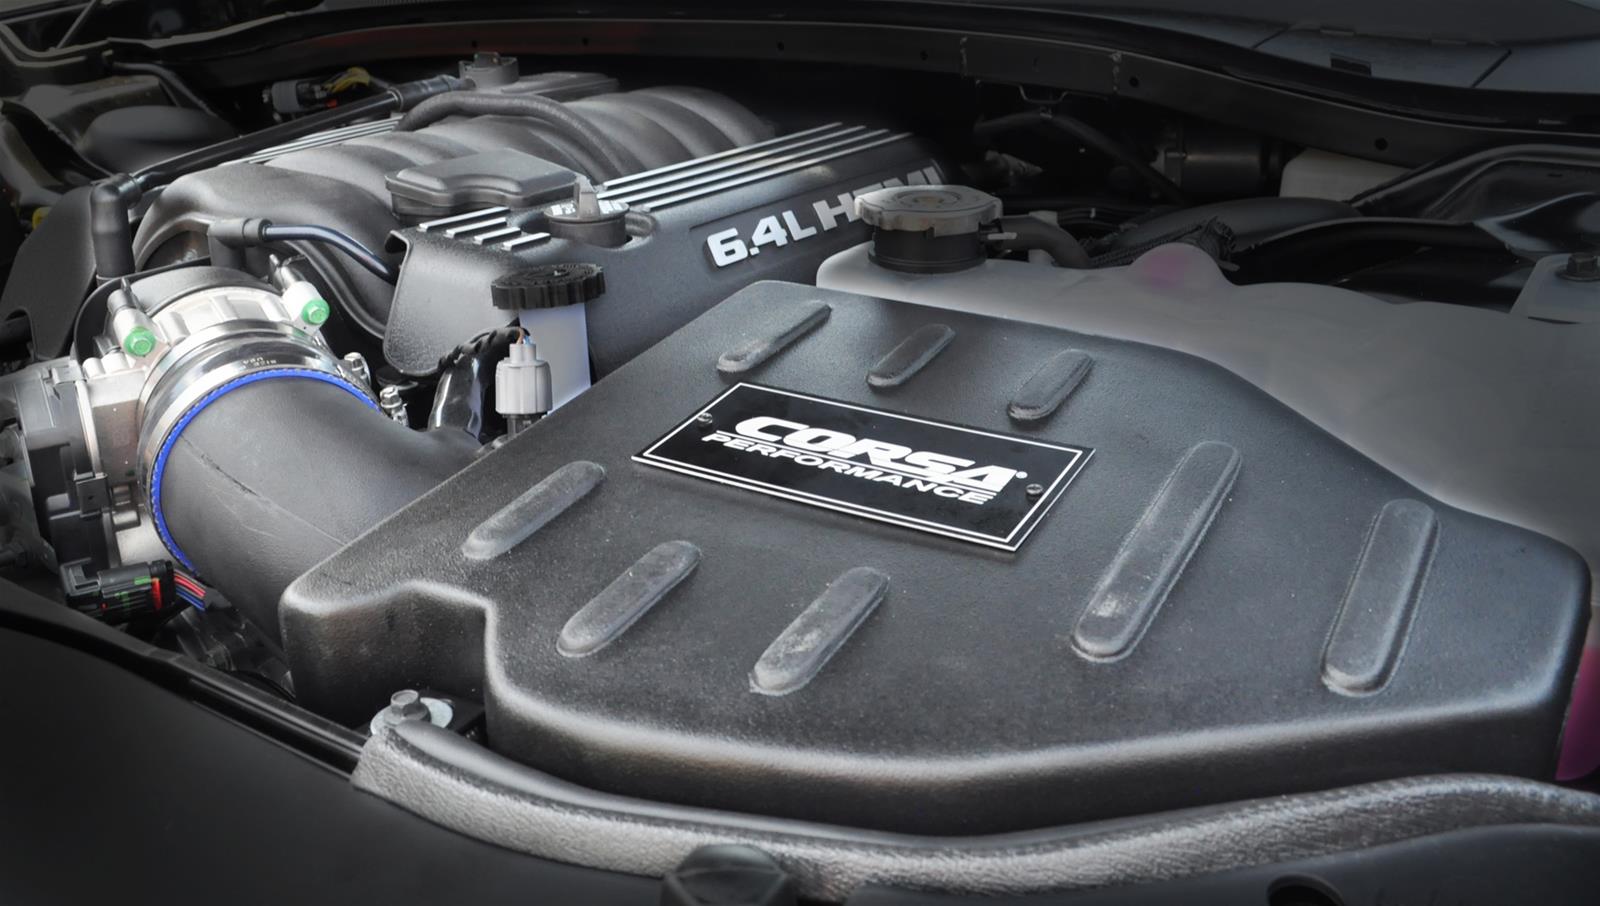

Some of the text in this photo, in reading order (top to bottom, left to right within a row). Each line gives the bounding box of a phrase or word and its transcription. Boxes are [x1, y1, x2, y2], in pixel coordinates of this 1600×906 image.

[707, 166, 942, 267] 6.4L HI
[701, 433, 997, 505] PERFORMANCE
[735, 416, 1018, 493] CORSA
